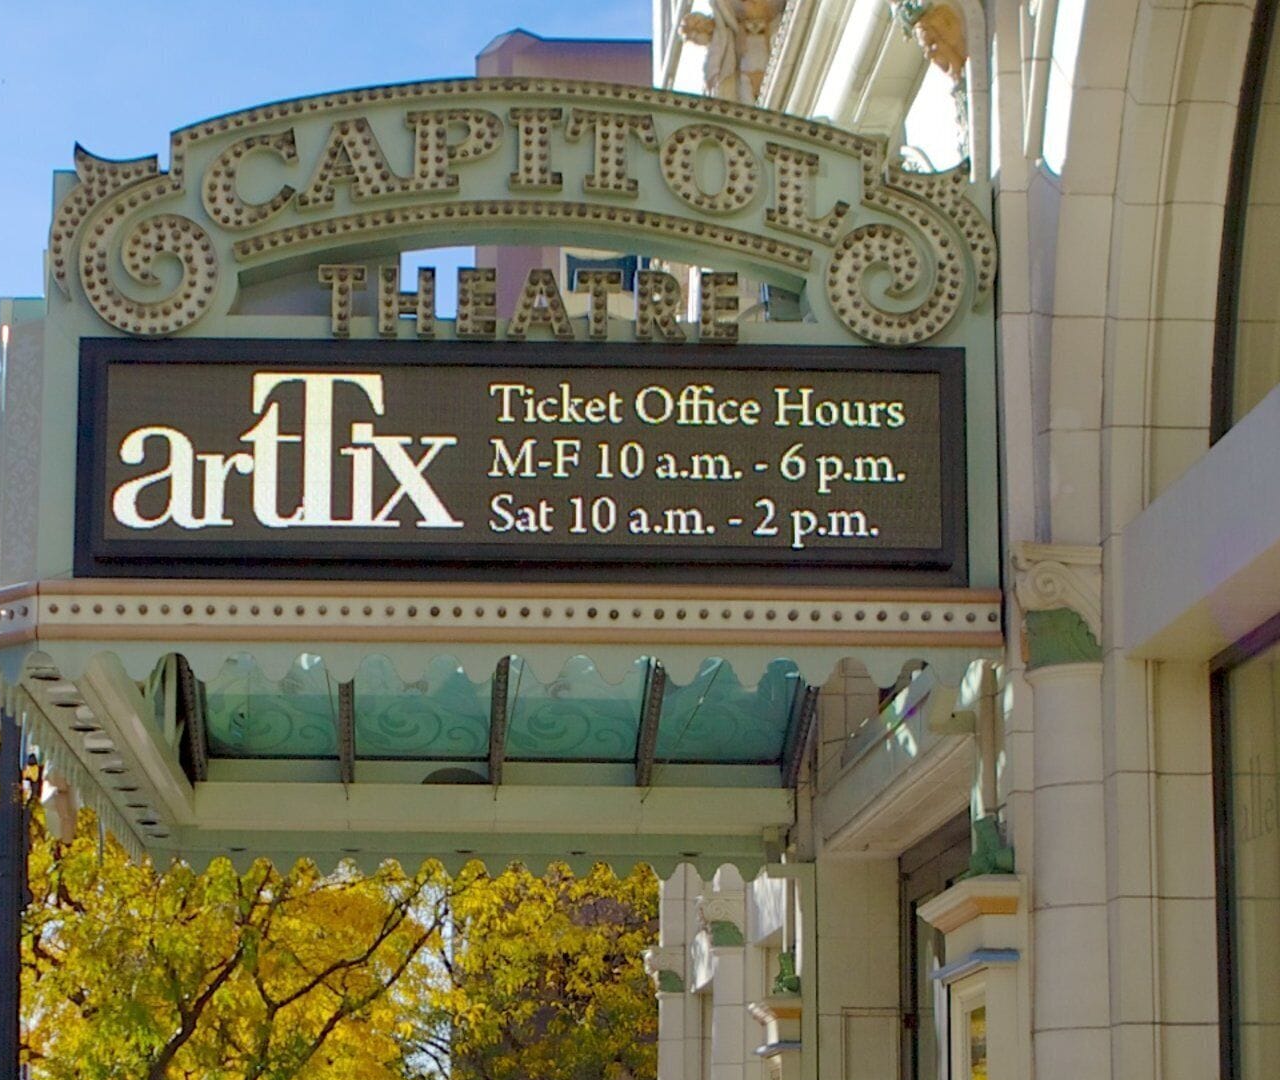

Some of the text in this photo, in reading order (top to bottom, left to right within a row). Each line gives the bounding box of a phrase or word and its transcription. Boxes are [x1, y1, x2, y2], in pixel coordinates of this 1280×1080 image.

[201, 106, 851, 248] CAPITOL
[318, 264, 741, 344] THEATRE
[489, 383, 907, 428] Ticket Office Hours
[487, 438, 582, 479] M-F
[596, 441, 646, 480] 10
[655, 451, 745, 481] a.m.
[779, 442, 807, 481] 6
[815, 452, 908, 494] p.m.
[488, 493, 556, 534] Sat
[568, 495, 618, 535] 10
[628, 506, 717, 536] a.m.
[752, 498, 780, 537] 2
[789, 507, 881, 549] p.m.
